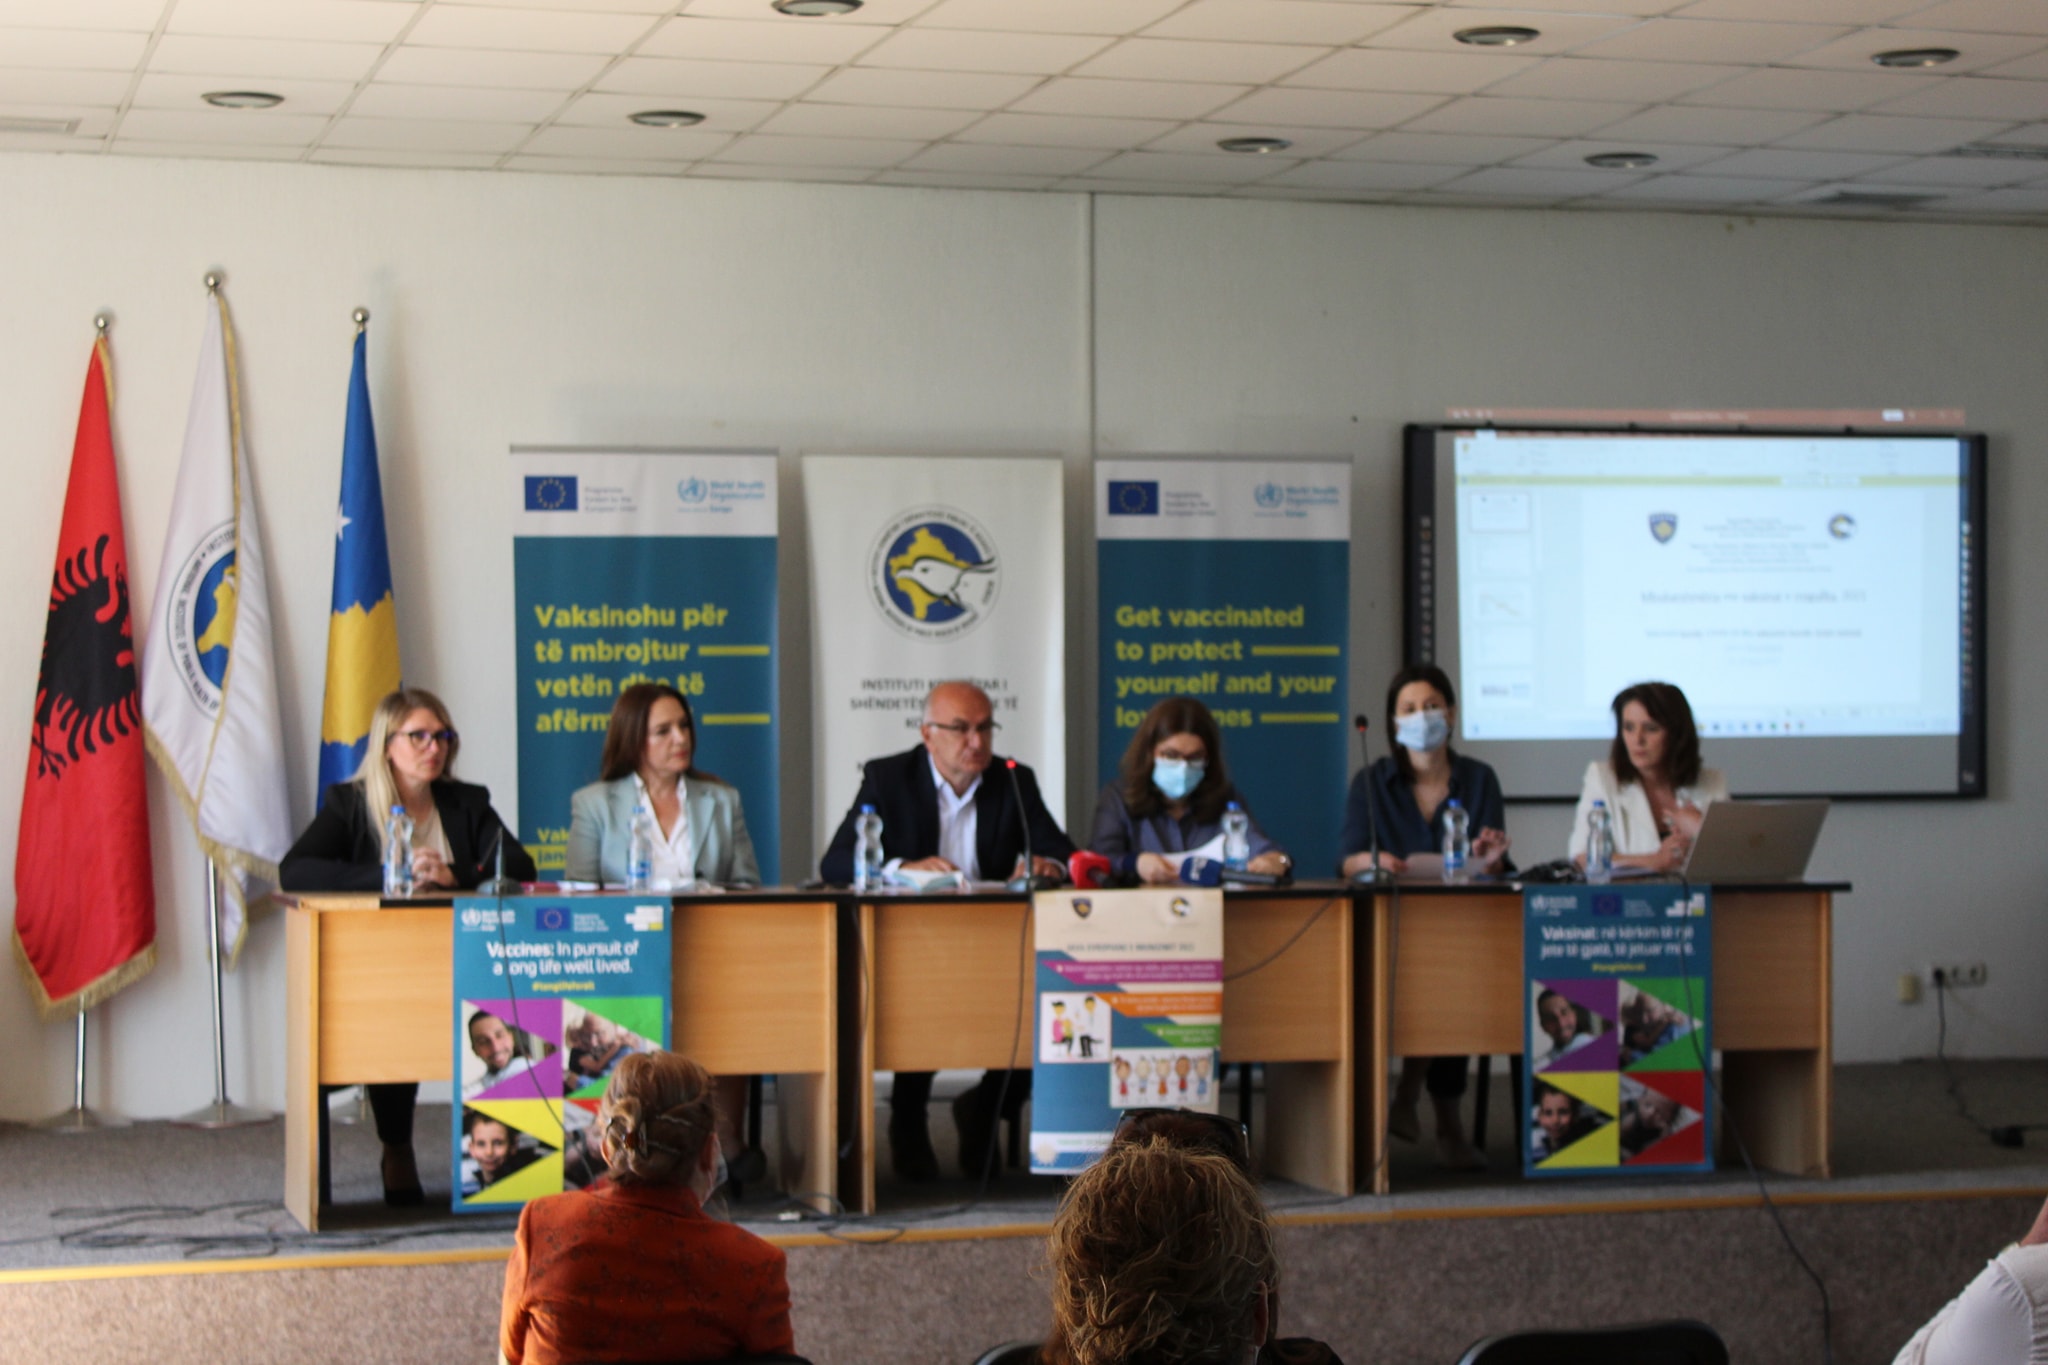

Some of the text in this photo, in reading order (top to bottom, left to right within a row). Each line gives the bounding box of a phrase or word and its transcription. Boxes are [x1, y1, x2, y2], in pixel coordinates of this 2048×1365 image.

[535, 603, 728, 631] Vaksinohu për
[1115, 604, 1305, 628] Get vaccinated
[535, 638, 690, 665] të mbrojtur
[1115, 639, 1243, 664] to protect
[535, 673, 613, 697] vetën
[677, 672, 705, 696] të
[1115, 671, 1336, 698] yourself and your
[486, 941, 555, 958] Vaccines:
[574, 940, 621, 958] pursuit
[624, 939, 640, 956] of
[493, 958, 633, 979] a ong life well lived.
